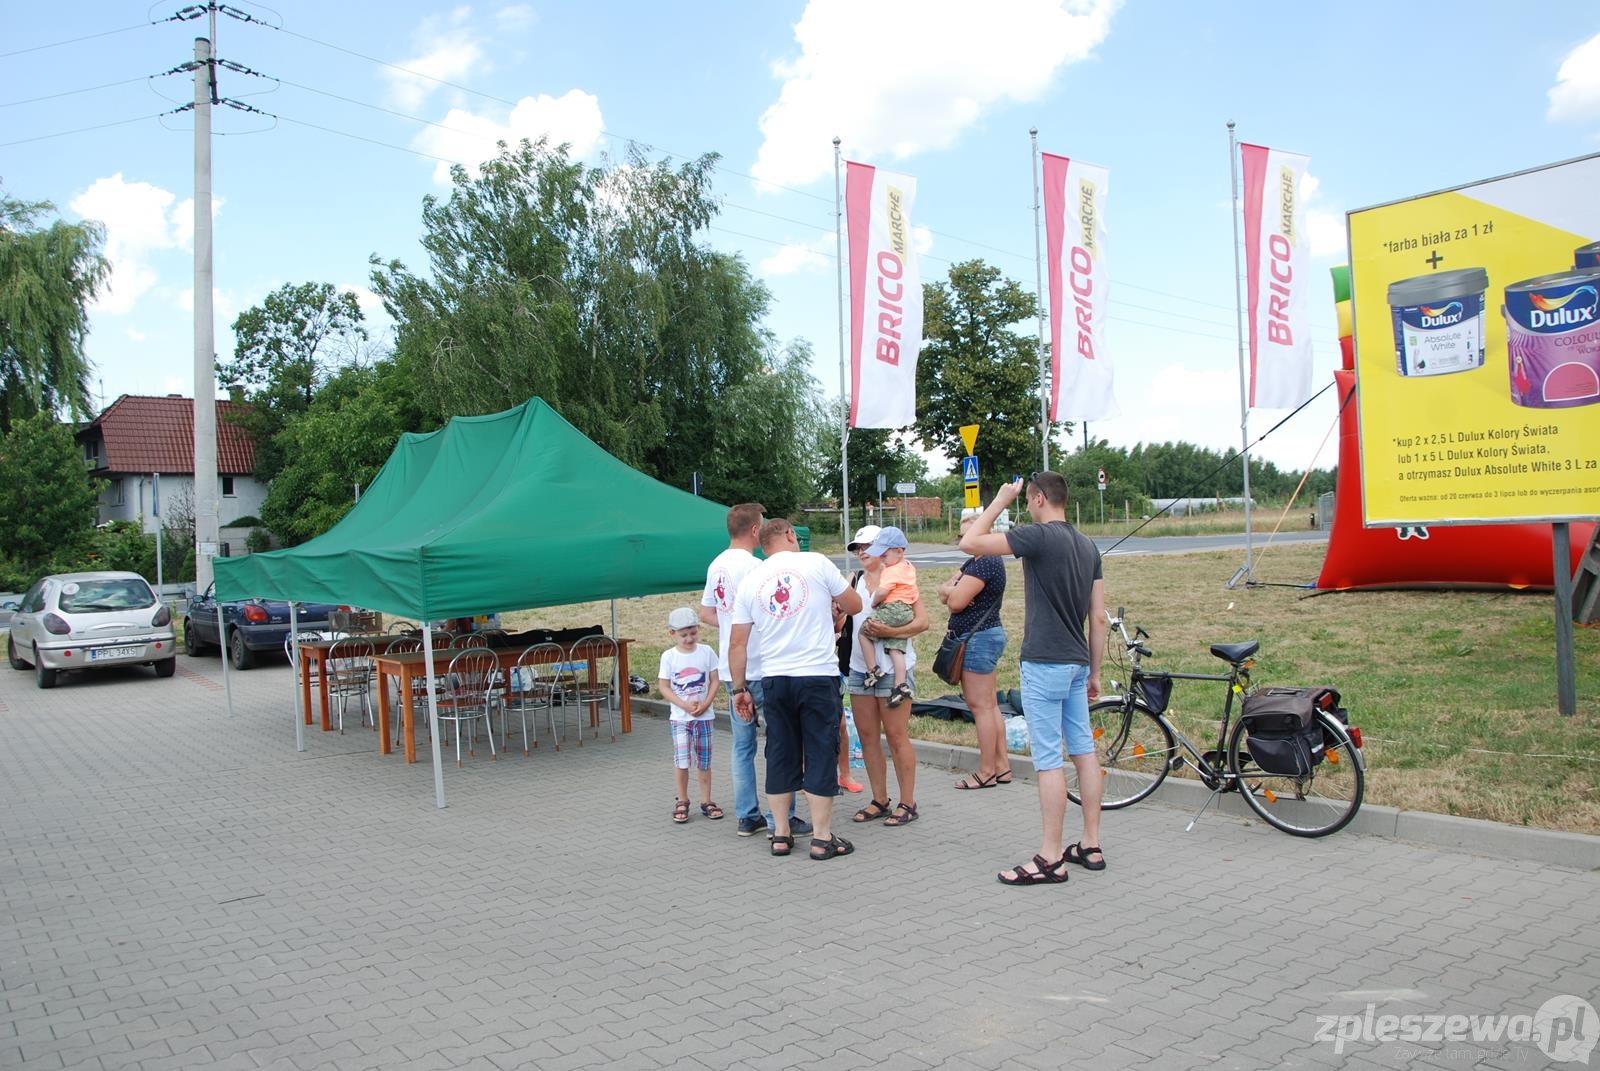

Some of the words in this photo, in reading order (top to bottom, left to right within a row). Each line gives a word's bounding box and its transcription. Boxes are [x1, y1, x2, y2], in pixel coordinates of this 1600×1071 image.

[1283, 173, 1293, 236] MARCHE
[888, 191, 904, 255] MARCHE
[1083, 185, 1094, 249] MARCHE
[1421, 231, 1451, 247] biała
[1455, 228, 1468, 240] za
[1471, 223, 1478, 236] 1
[1482, 220, 1494, 235] zł
[1268, 234, 1293, 346] BRICO
[876, 250, 903, 367] BRICO
[1070, 246, 1095, 360] BRICO
[1421, 313, 1458, 328] Dulux
[1530, 306, 1593, 329] Dulux
[1424, 332, 1461, 344] Absolute
[1430, 342, 1456, 352] White
[1415, 435, 1421, 446] 2
[1423, 437, 1429, 446] x
[1449, 432, 1455, 443] L
[1457, 431, 1485, 442] Dulux
[1488, 428, 1520, 441] Kolory
[1523, 423, 1559, 437] Świata
[1397, 453, 1412, 464] lub
[1414, 452, 1420, 463] 1
[1422, 453, 1428, 462] x
[1430, 451, 1436, 462] 5
[1438, 450, 1445, 461] L
[1447, 449, 1474, 461] Dulux
[1476, 447, 1508, 459] Kolory
[1398, 472, 1404, 481] a
[1406, 469, 1452, 481] otrzymasz
[1454, 466, 1482, 477] Dulux
[1484, 463, 1528, 476] Absolute
[1531, 461, 1562, 473] White
[1564, 459, 1572, 471] 3
[1575, 459, 1582, 470] L
[1585, 460, 1597, 470] za
[1517, 488, 1528, 497] lub
[1529, 488, 1538, 496] do
[1540, 486, 1582, 497] wyczerpania
[97, 650, 113, 658] PPL
